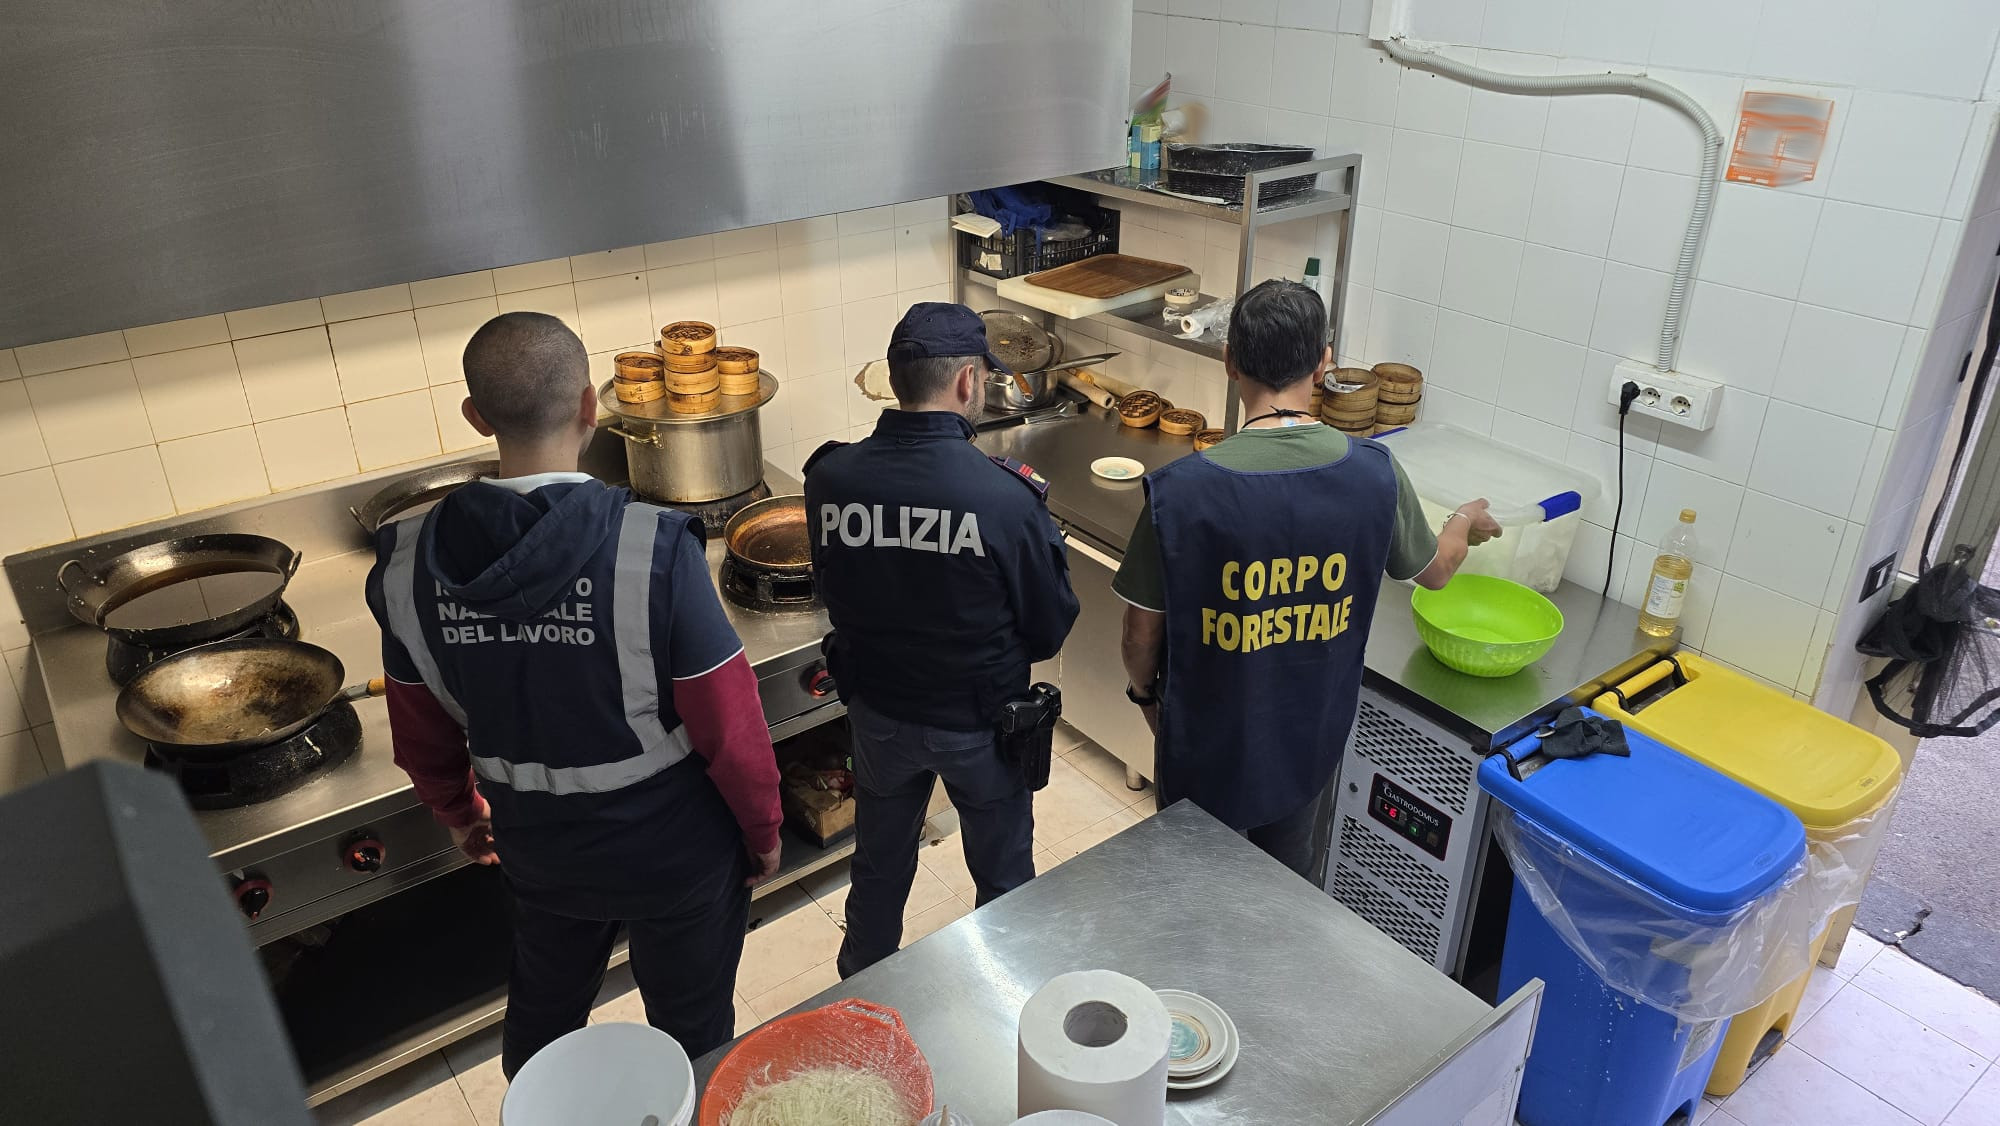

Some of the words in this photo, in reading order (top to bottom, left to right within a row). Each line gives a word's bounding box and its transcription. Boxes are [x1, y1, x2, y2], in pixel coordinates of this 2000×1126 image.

[821, 502, 986, 557] POLIZIA
[1221, 552, 1347, 601] CORPO
[441, 624, 495, 644] DEL
[500, 624, 596, 646] LAVORO
[1202, 595, 1353, 653] FORESTALE
